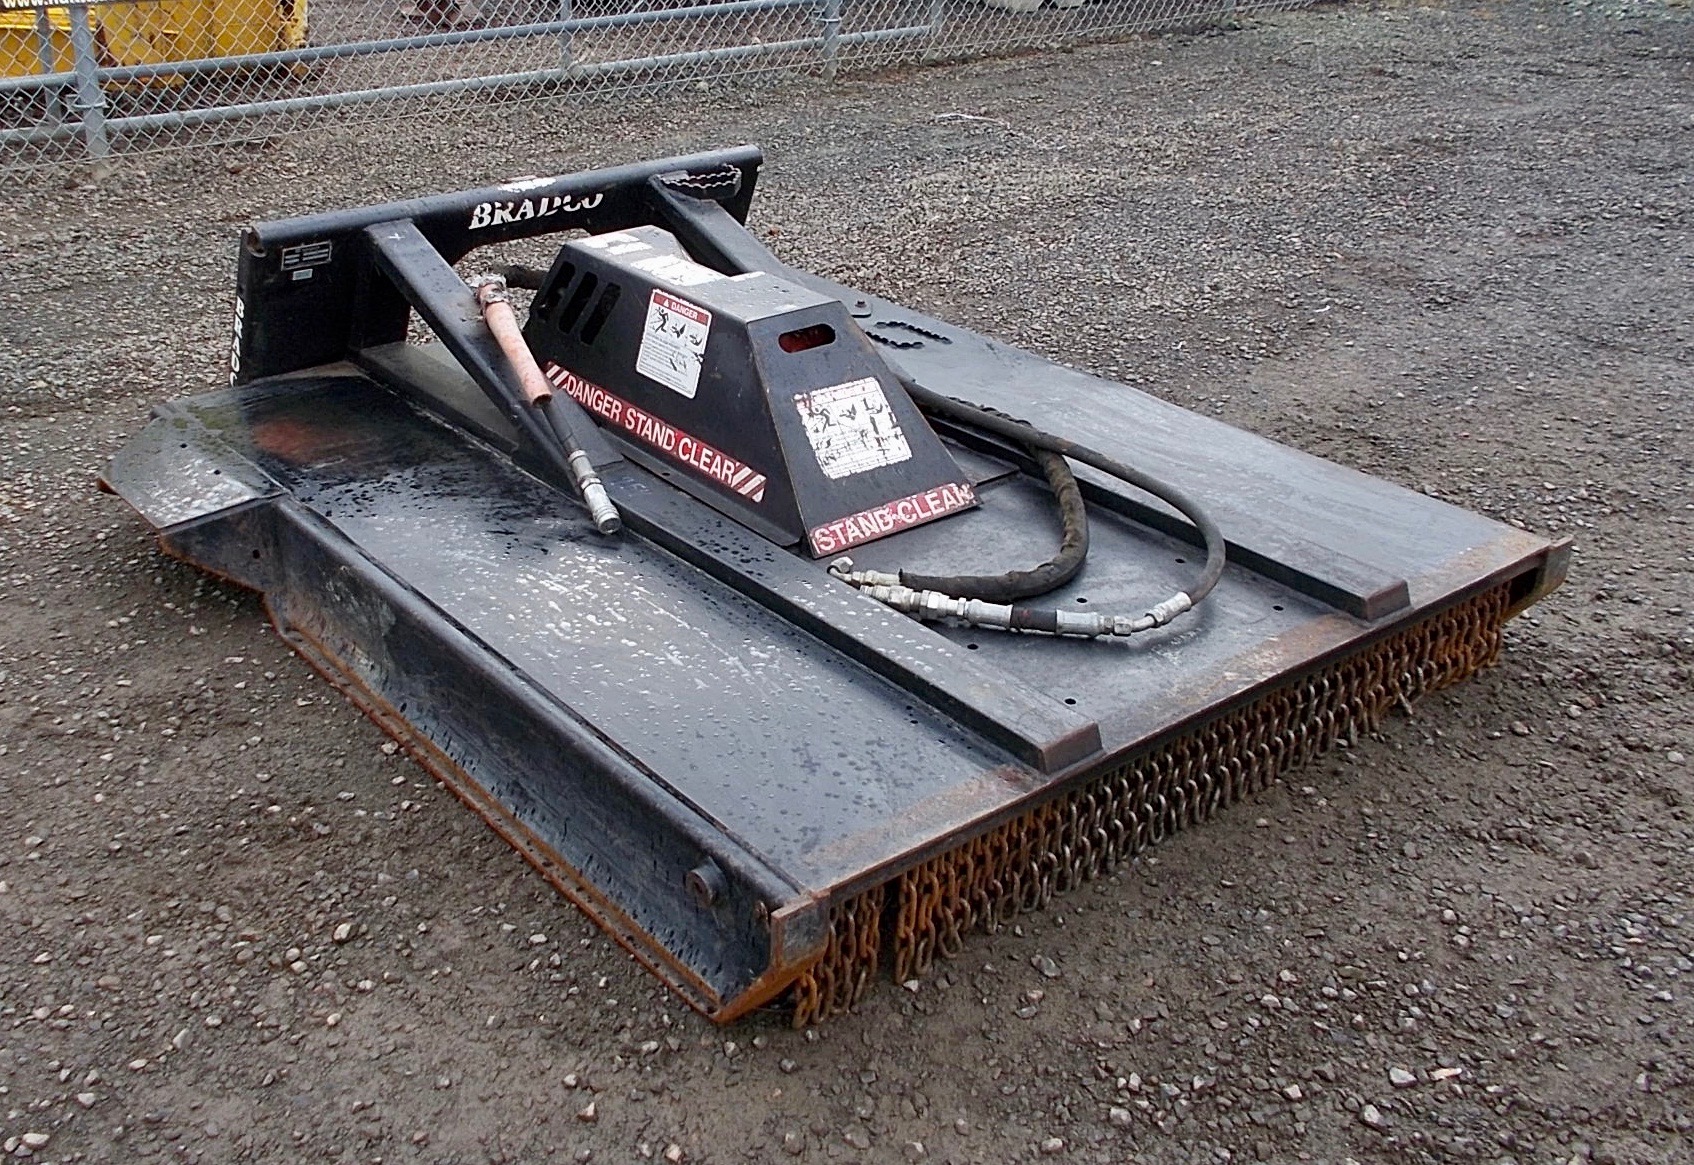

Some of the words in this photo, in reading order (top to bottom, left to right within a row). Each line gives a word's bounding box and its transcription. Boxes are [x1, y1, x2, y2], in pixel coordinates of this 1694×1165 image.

[671, 302, 698, 320] DANGER
[565, 375, 622, 423] DANGER
[624, 407, 676, 451] STAND
[678, 438, 735, 485] CLEAR
[814, 508, 894, 551] STAND
